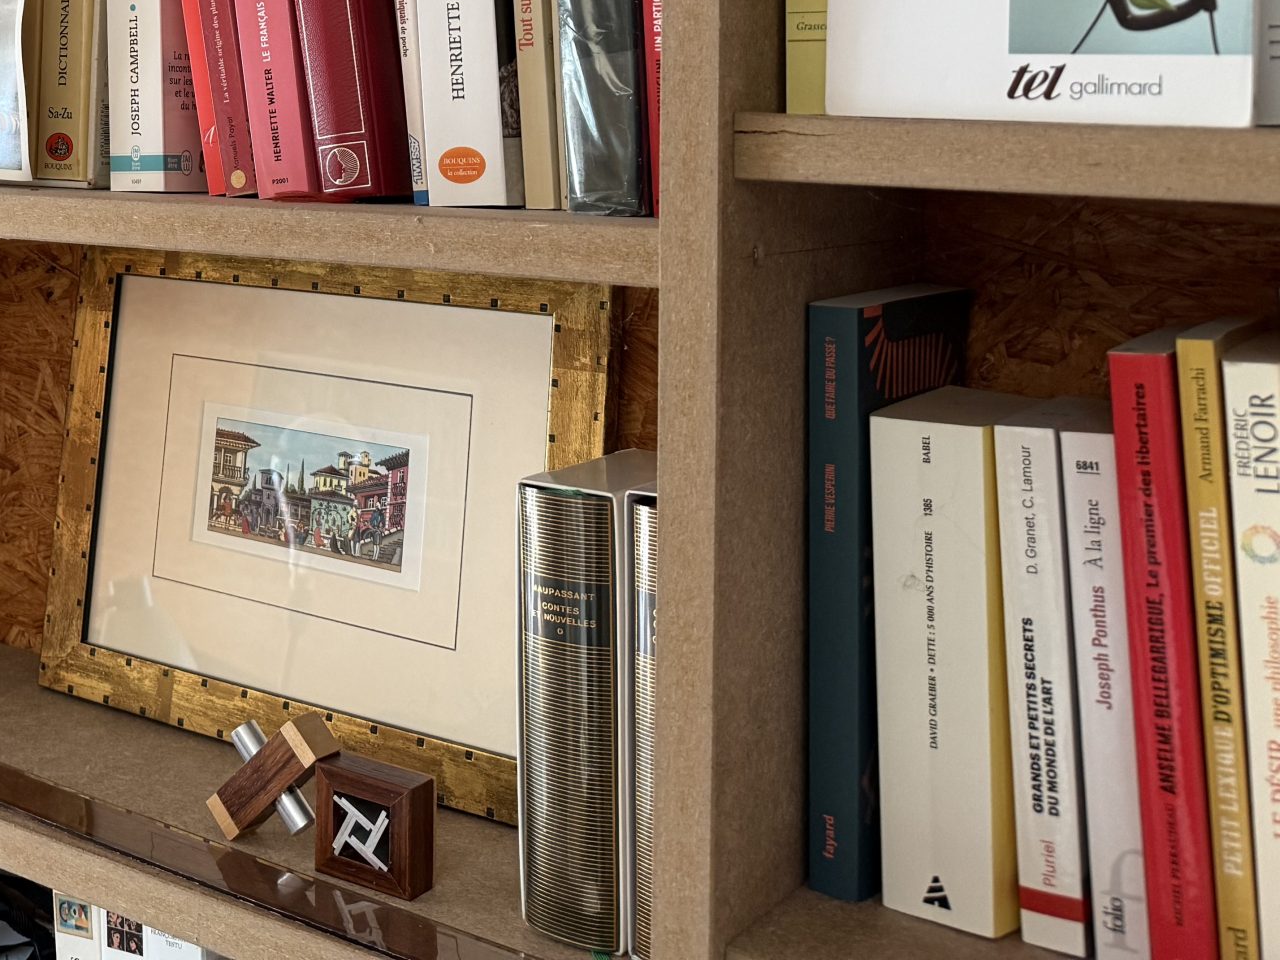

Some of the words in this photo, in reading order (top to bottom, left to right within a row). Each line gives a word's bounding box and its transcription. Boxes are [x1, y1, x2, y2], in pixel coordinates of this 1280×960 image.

[129, 14, 141, 82] CAMPBELL
[447, 1, 465, 101] HENRIETTE
[518, 20, 534, 52] Tout
[1006, 62, 1066, 101] tel
[1069, 73, 1163, 101] gallimard
[130, 86, 142, 137] JOSEPH
[442, 156, 481, 165] BOUQUINS
[1190, 367, 1210, 423] Farrachi
[922, 435, 931, 464] BABEL
[1194, 424, 1215, 484] Armand
[1232, 408, 1250, 478] FRÉDÉRIC
[1248, 393, 1280, 495] LENOIR
[1075, 459, 1100, 471] 6841
[924, 530, 934, 582] D'HISTOIRE
[533, 584, 595, 601] MAUPASSANT
[541, 601, 580, 616] CONTES
[926, 582, 935, 605] ANS
[543, 613, 597, 628] NOUVELLES
[927, 606, 935, 622] 000
[927, 638, 937, 666] DETTE
[1021, 617, 1038, 680] SECRETS
[927, 675, 938, 718] GRAEBER
[1026, 682, 1040, 732] PETITS
[1040, 677, 1054, 715] L'ART
[928, 719, 939, 750] DAVID
[1029, 733, 1041, 751] ET
[1043, 716, 1055, 734] DE
[1030, 752, 1045, 814] GRANDS
[1045, 735, 1059, 792] MONDE
[1047, 794, 1060, 818] DU
[822, 814, 839, 859] fayard
[1040, 839, 1056, 888] Pluriel
